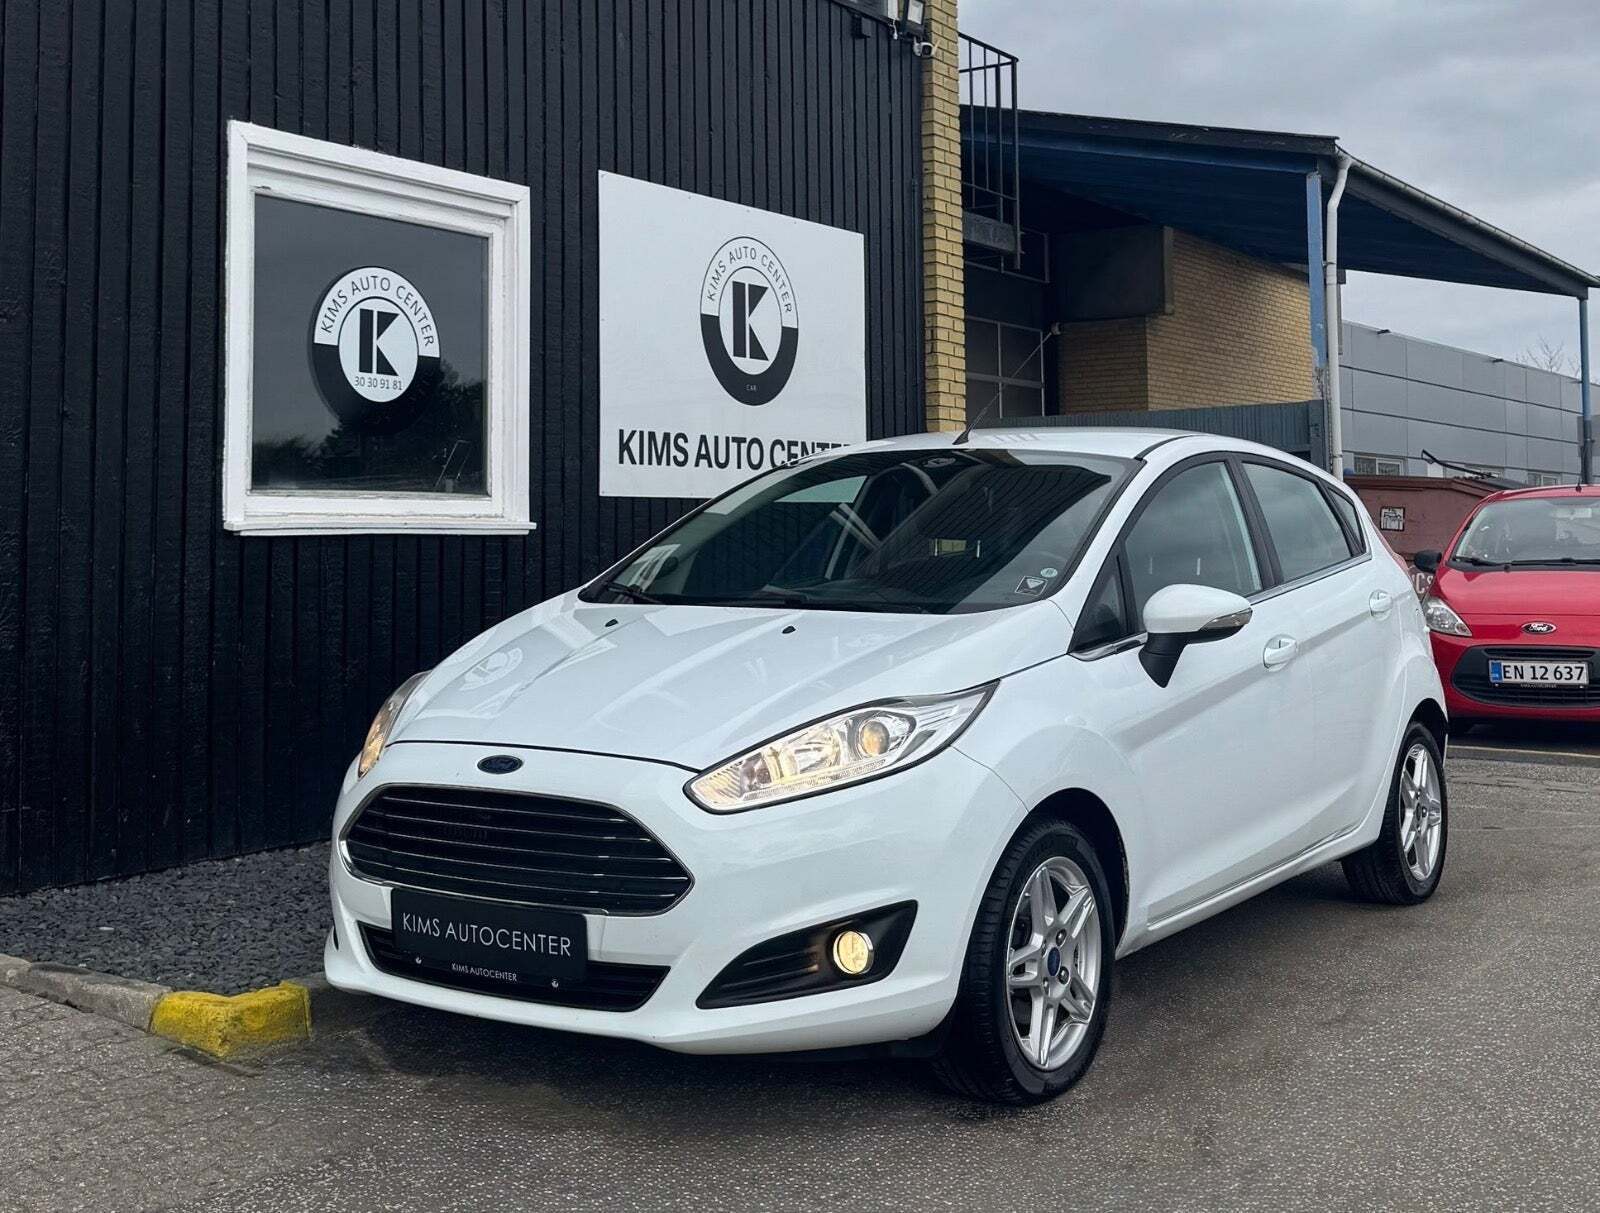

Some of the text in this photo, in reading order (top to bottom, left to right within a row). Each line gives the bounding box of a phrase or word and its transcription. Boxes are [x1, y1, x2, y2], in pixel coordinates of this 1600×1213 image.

[707, 246, 792, 313] KIMS AUTO CENTER
[321, 275, 434, 347] KIMS AUTO CENTER
[732, 280, 769, 361] K
[358, 308, 400, 376] K
[354, 376, 403, 391] 30 30 91 81
[618, 429, 689, 467] KIMS
[694, 434, 764, 470] AUTO
[1503, 665, 1524, 680] EN
[1530, 665, 1549, 681] 12
[1553, 665, 1584, 681] 637
[402, 912, 571, 957] KIMS AUTOCENTER
[451, 962, 517, 982] KIMS AUTOCENTER
